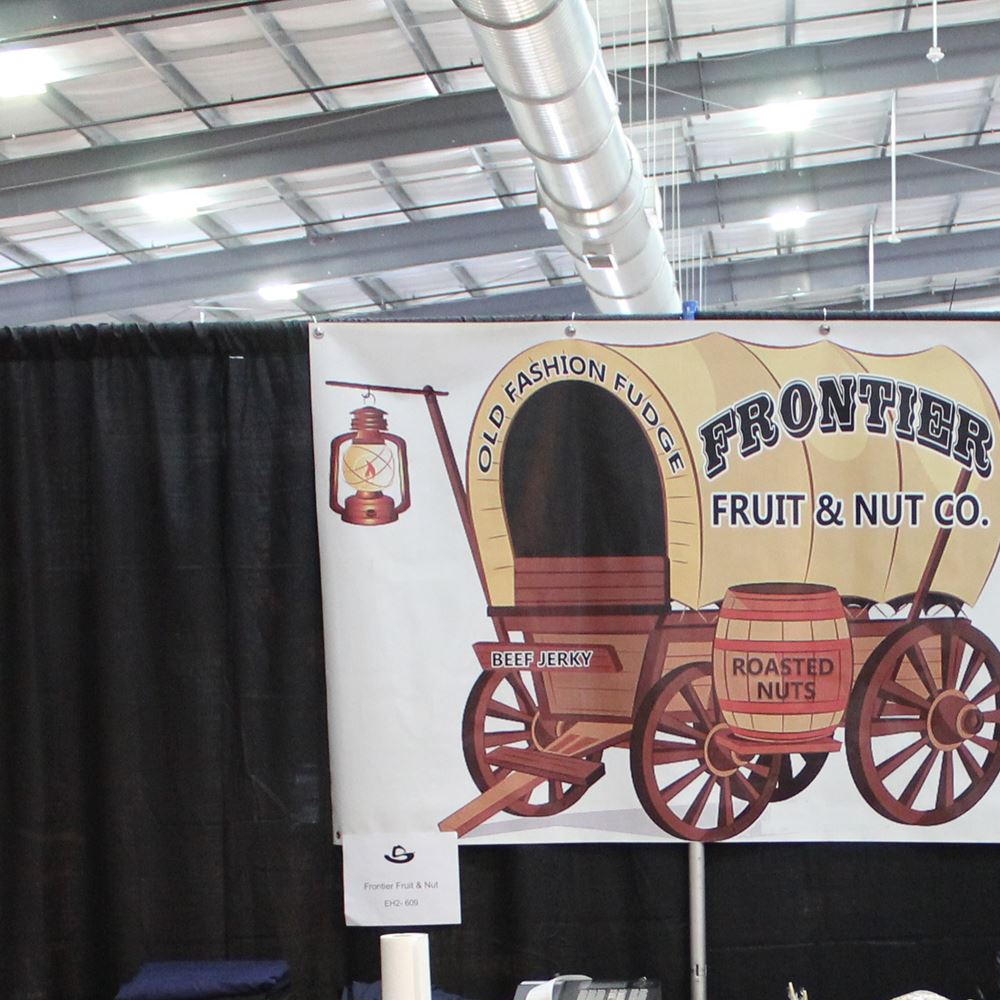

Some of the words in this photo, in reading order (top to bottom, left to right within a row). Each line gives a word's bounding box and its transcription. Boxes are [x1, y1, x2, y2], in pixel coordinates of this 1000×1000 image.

[478, 404, 505, 473] OLD
[504, 355, 606, 403] FASHION
[613, 373, 685, 473] FUDGE
[698, 375, 994, 479] FRONTIER
[712, 494, 805, 526] FRUIT
[815, 494, 844, 526] &
[855, 494, 924, 526] NUT
[934, 494, 989, 526] CO.
[492, 652, 533, 667] BEEF
[538, 651, 593, 667] JERKY
[732, 657, 834, 677] ROASTED
[757, 681, 816, 701] NUTS
[363, 882, 393, 891] Frontier
[395, 881, 414, 890] Fruit
[416, 881, 422, 889] &
[424, 881, 439, 889] Nut
[405, 899, 419, 907] 609
